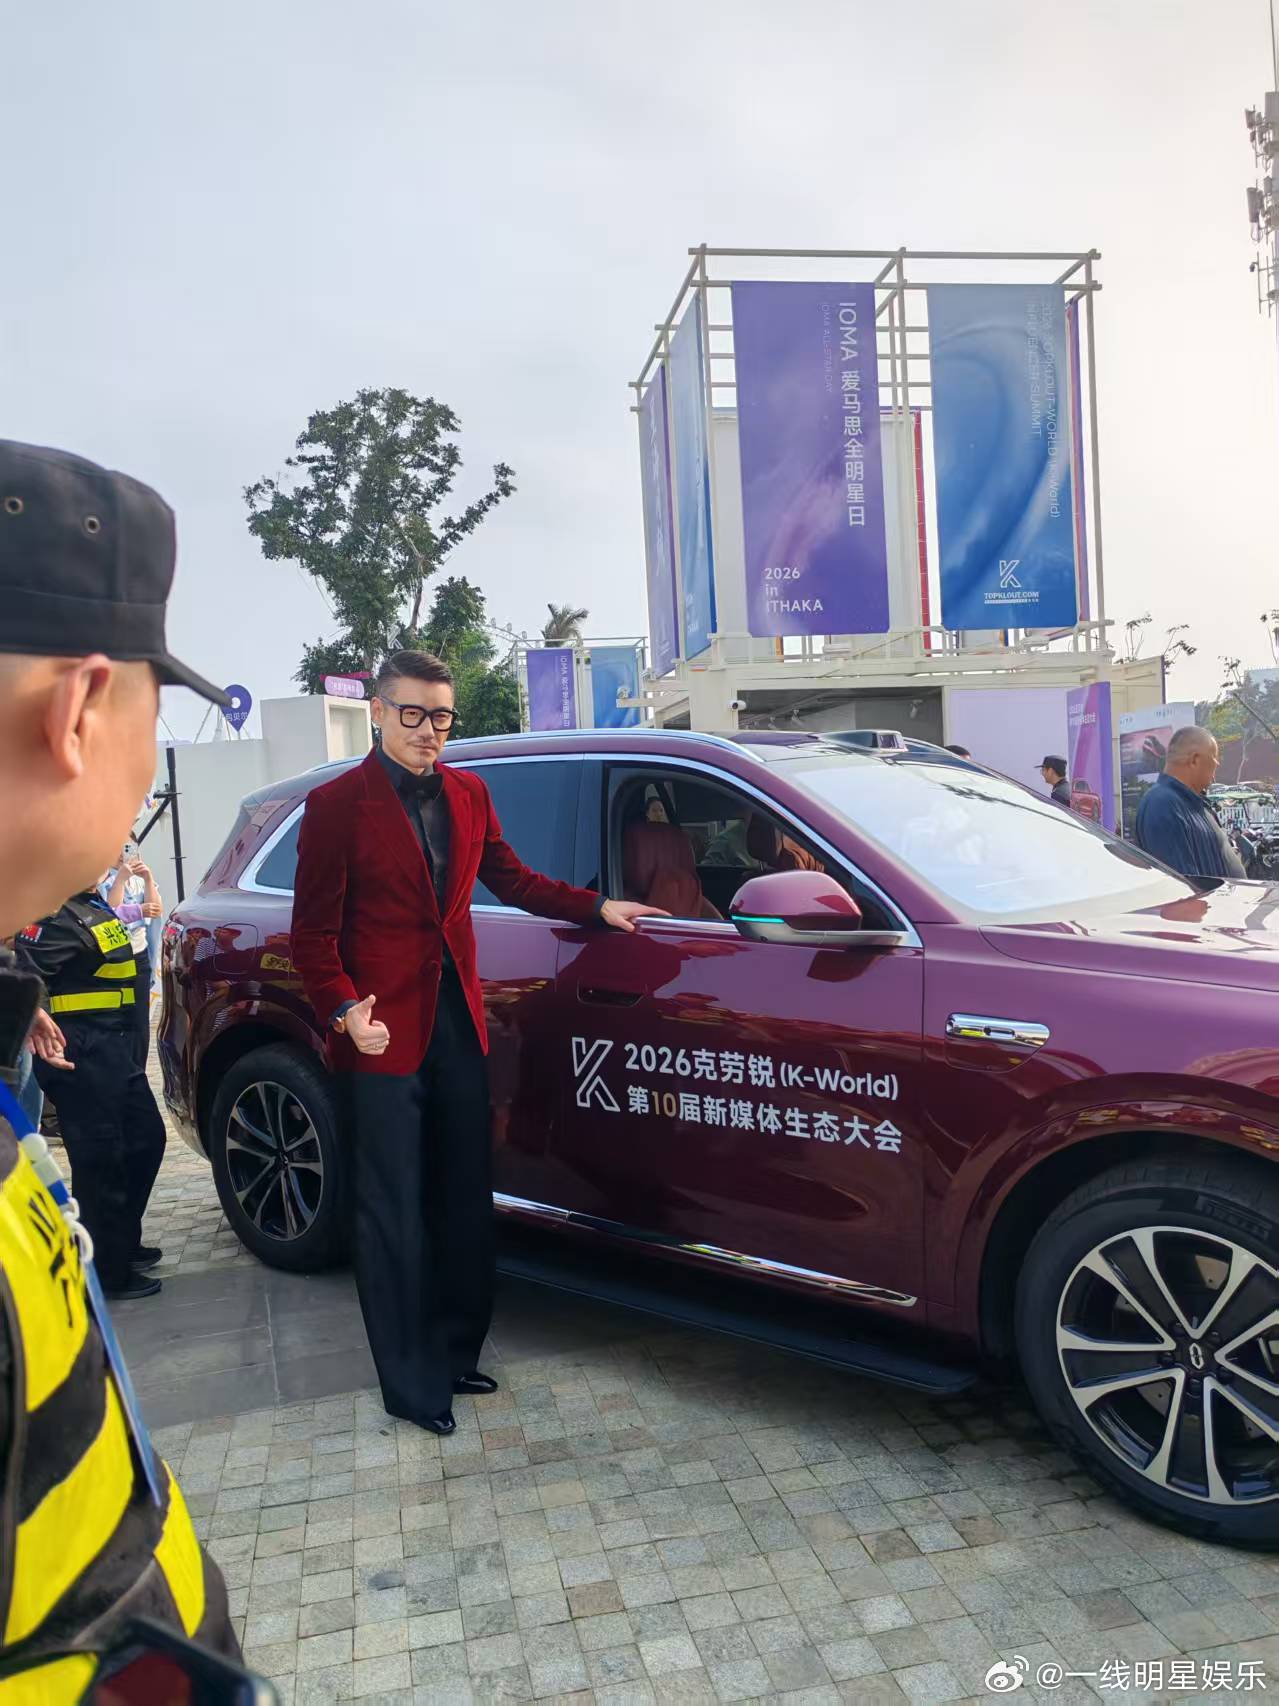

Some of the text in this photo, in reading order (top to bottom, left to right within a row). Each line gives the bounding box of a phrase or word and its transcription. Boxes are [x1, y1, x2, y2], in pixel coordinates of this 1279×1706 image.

[839, 302, 865, 527] IOMA 爱马思全明星日
[764, 567, 801, 580] 2026
[765, 583, 778, 597] in
[766, 599, 824, 612] ITHAKA
[626, 1084, 903, 1154] 第10届新媒体生态大会
